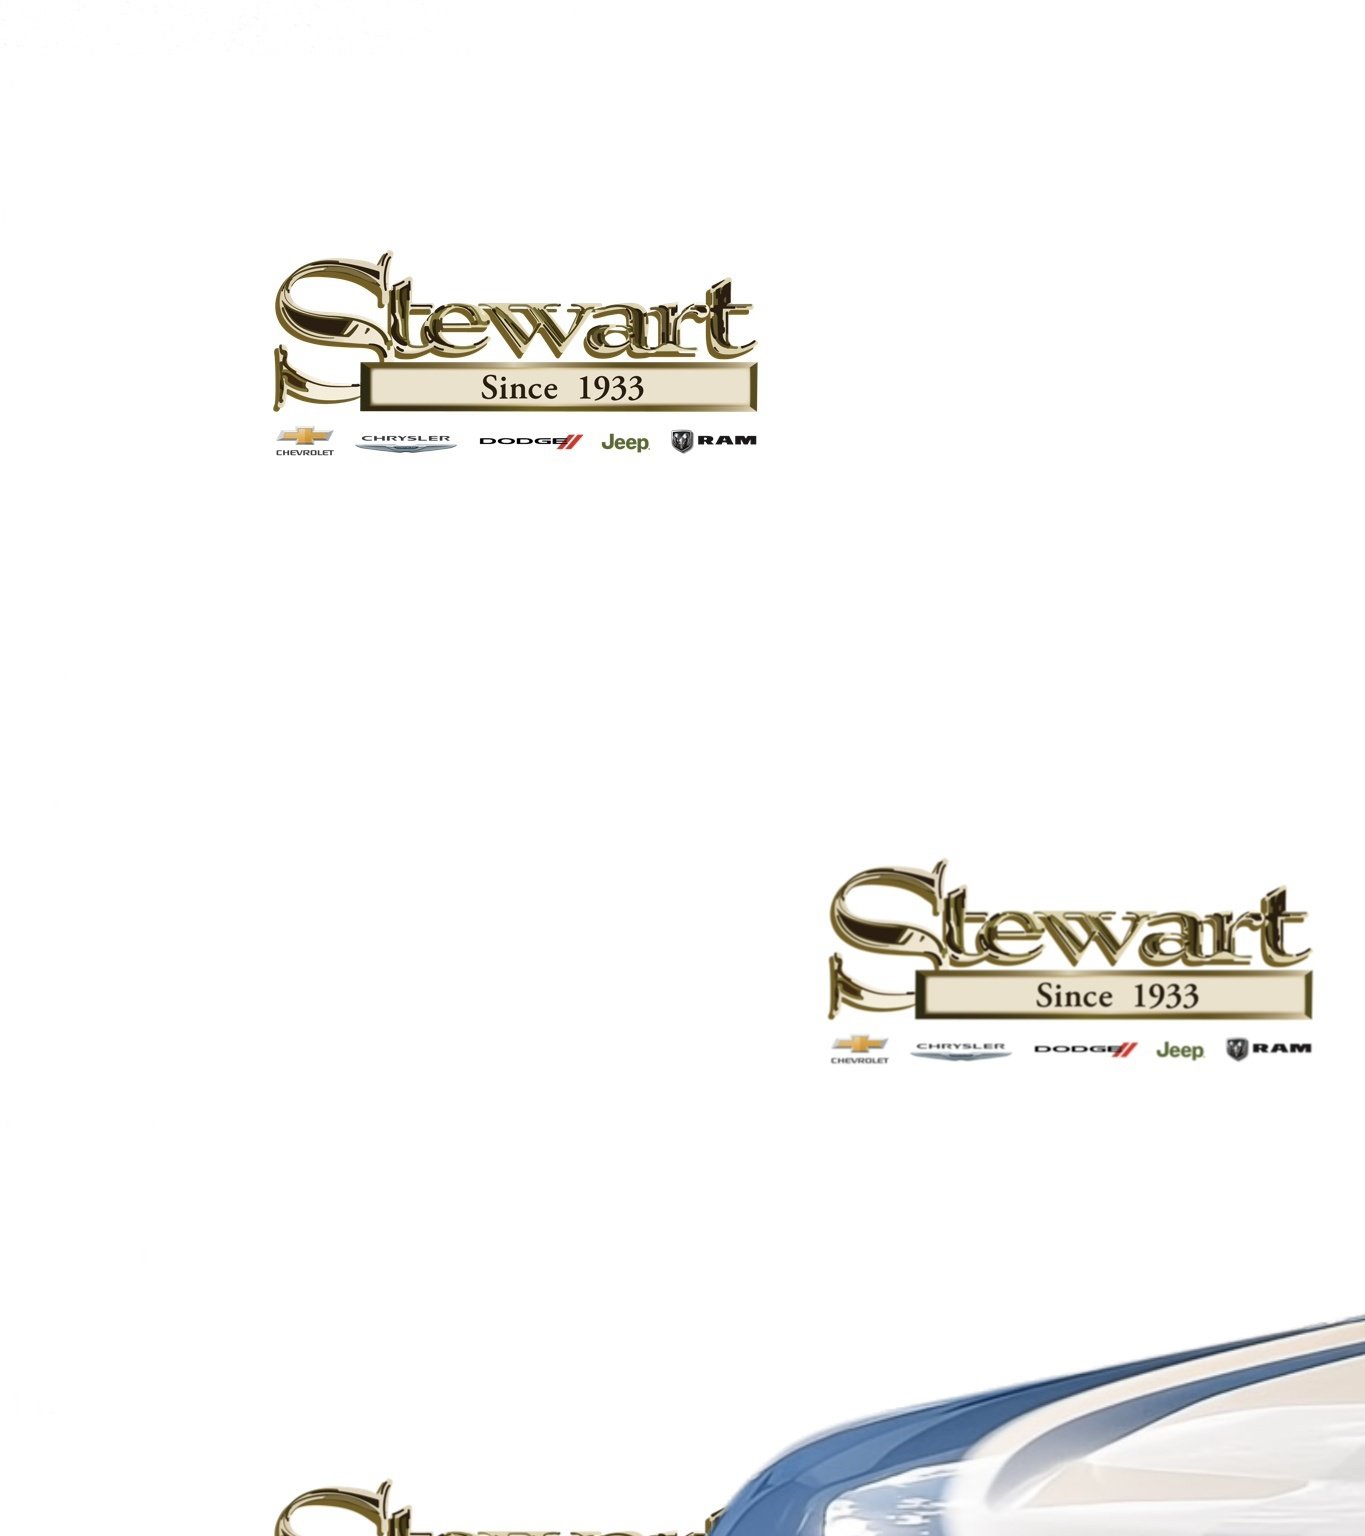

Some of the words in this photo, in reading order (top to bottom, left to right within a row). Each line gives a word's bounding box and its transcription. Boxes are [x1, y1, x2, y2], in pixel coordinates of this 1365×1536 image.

[273, 249, 758, 412] Stewart
[481, 374, 558, 400] Since
[579, 375, 645, 401] 1933
[275, 449, 335, 457] CHEVROLET
[361, 435, 451, 443] CHRYSLER
[479, 437, 568, 446] DODGE
[601, 433, 649, 453] Jeep
[697, 434, 758, 446] RAM
[828, 857, 1313, 1020] Stewart
[1036, 982, 1113, 1008] Since
[1134, 983, 1200, 1009] 1933
[830, 1057, 890, 1065] CHEVROLET
[916, 1043, 1006, 1051] CHRYSLER
[1034, 1045, 1123, 1054] DODGE
[1156, 1041, 1204, 1061] Jeep
[1252, 1042, 1313, 1054] RAM
